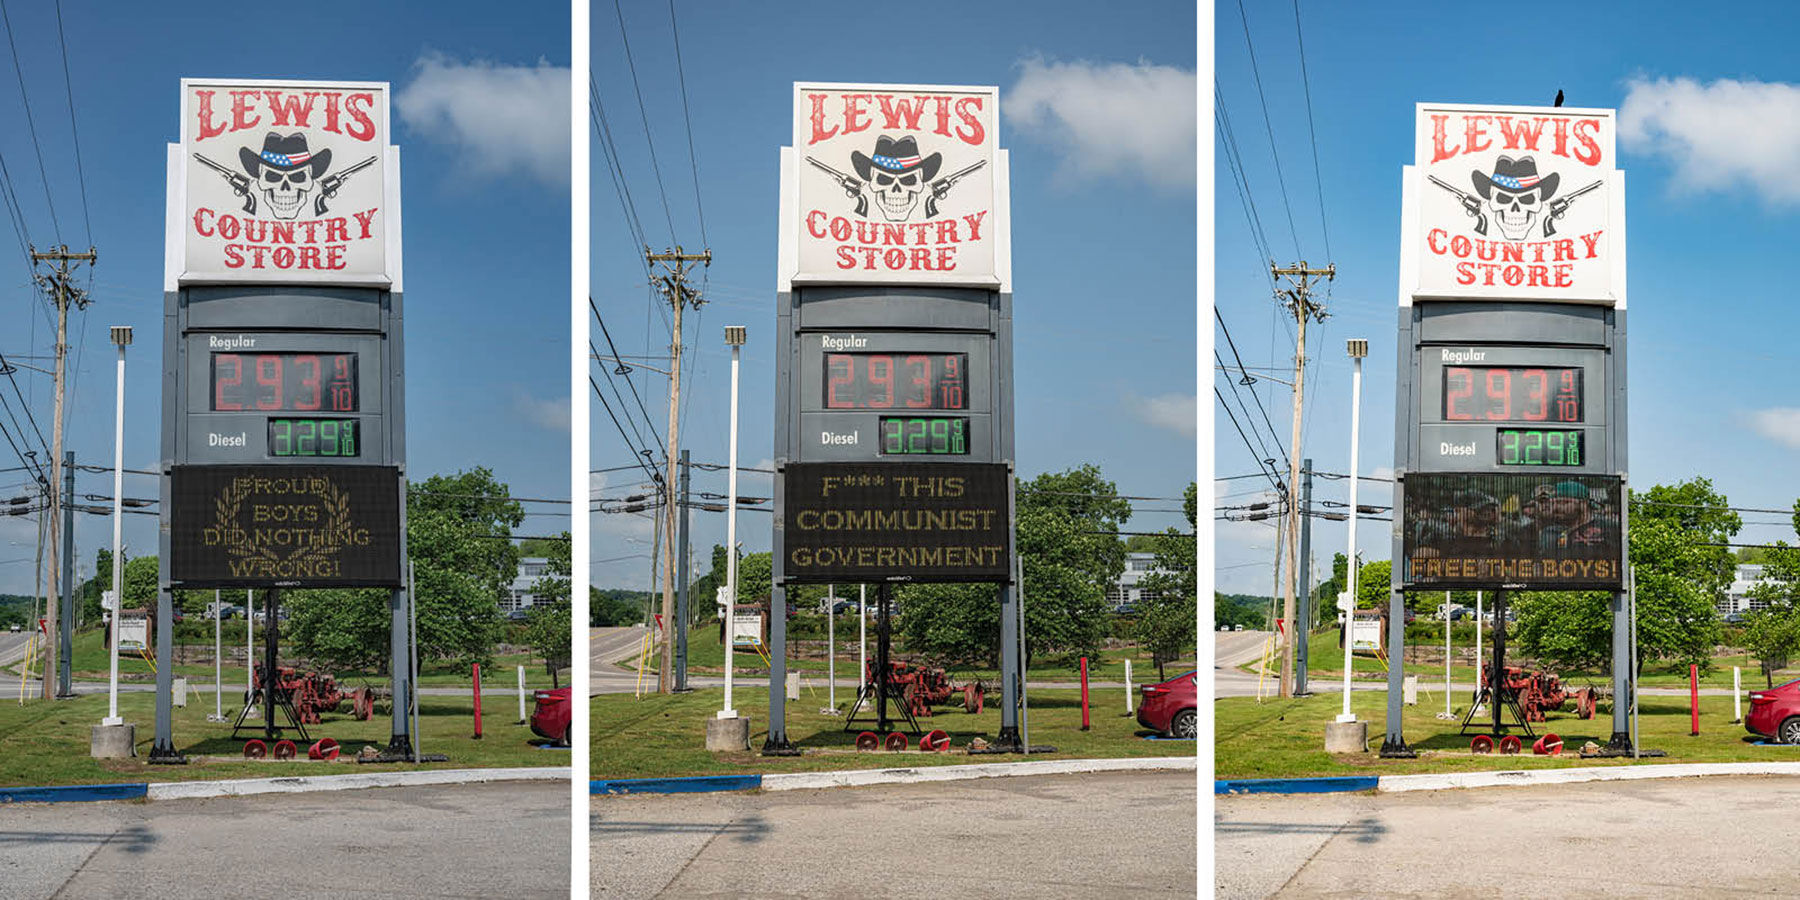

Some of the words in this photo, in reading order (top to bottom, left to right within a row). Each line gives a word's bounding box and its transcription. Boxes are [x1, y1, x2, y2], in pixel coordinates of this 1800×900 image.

[195, 90, 376, 142] LEWIS
[807, 94, 985, 146] LEWIS
[1430, 114, 1603, 166] LEWIS
[193, 208, 378, 244] COUNTRY
[805, 209, 988, 246] COUNTRY
[224, 244, 347, 270] STORE
[836, 245, 957, 271] STORE
[1427, 228, 1604, 263] COUNTRY
[1456, 261, 1573, 288] STORE
[209, 335, 256, 350] Regular
[822, 335, 868, 351] Regular
[1441, 348, 1486, 364] Regular
[215, 354, 321, 411] 2.93
[827, 354, 932, 409] 2.93
[1446, 367, 1548, 421] 2.93
[208, 432, 246, 447] Diesel
[273, 419, 339, 456] 3.29
[821, 431, 858, 445] Diesel
[886, 418, 949, 454] 3.29
[1440, 442, 1476, 456] Diesel
[1503, 430, 1564, 465] 3.29
[237, 478, 327, 494] PROUD
[892, 476, 966, 498] THIS
[252, 504, 319, 522] BOYS
[796, 508, 997, 531] COMMUNIST
[203, 528, 247, 546] DID
[255, 528, 370, 546] NOTHING
[228, 560, 342, 577] WRONG!
[791, 545, 1003, 567] GOVERNMENT
[1410, 557, 1477, 578] FREE
[1486, 557, 1534, 578] THE
[1542, 558, 1617, 578] BOYS!
